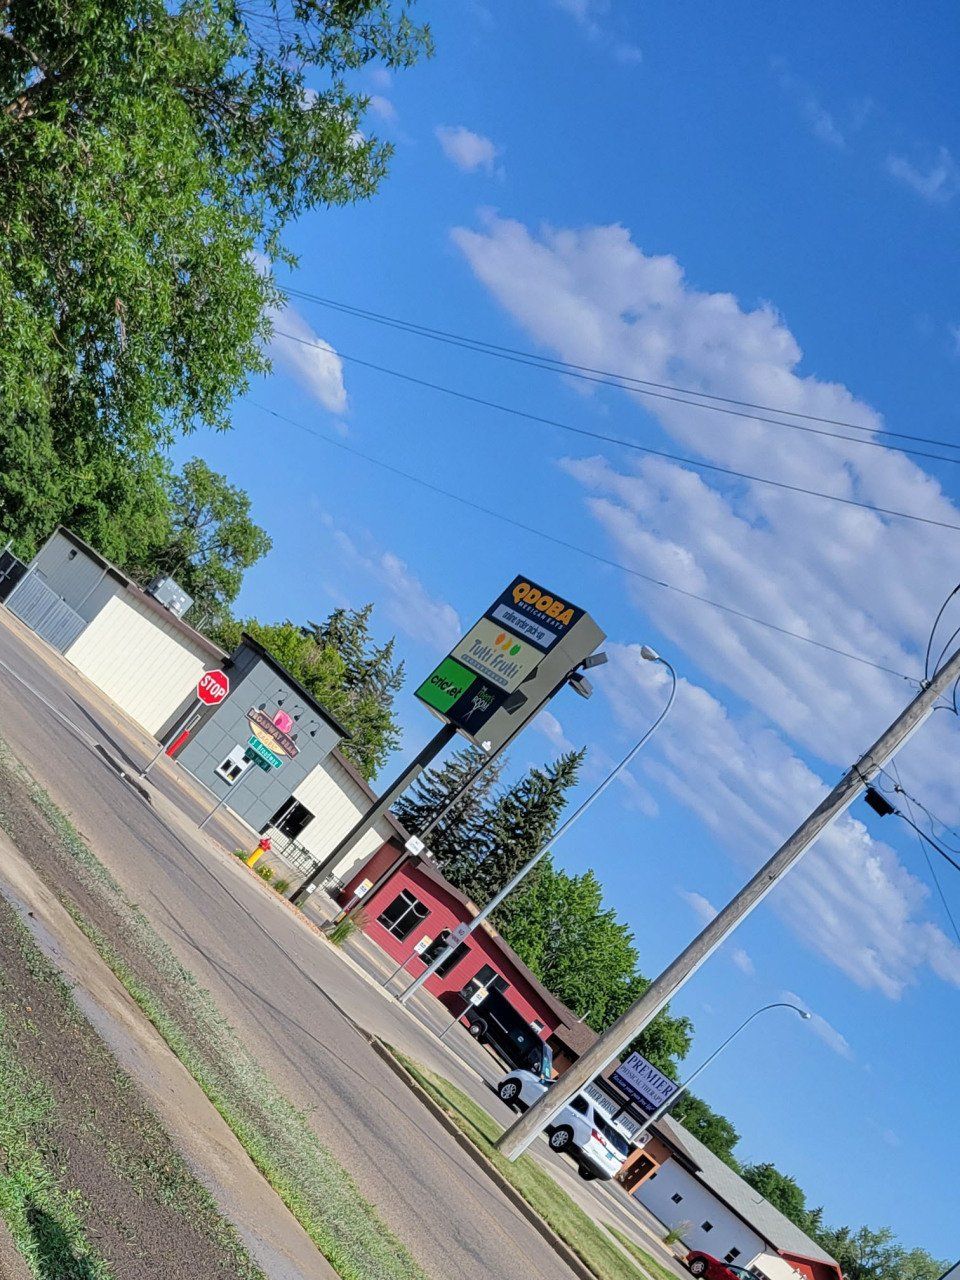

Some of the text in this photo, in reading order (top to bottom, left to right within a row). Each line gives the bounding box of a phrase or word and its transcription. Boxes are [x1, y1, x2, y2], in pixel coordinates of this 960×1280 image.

[512, 582, 575, 625] QDOBA
[518, 600, 563, 630] MEXICAN EATS
[502, 610, 516, 624] online
[515, 617, 529, 630] order
[469, 638, 496, 662] Tutti
[201, 675, 226, 698] STOP
[430, 674, 463, 699] cricket
[248, 710, 282, 740] BROADWAY
[280, 738, 297, 756] BEAN
[256, 742, 279, 766] Broadway
[620, 1065, 663, 1104] PHYSICAL THERAPY
[627, 1054, 674, 1097] PREMIER
[584, 1084, 603, 1103] EMIER
[620, 1115, 638, 1135] THERA
